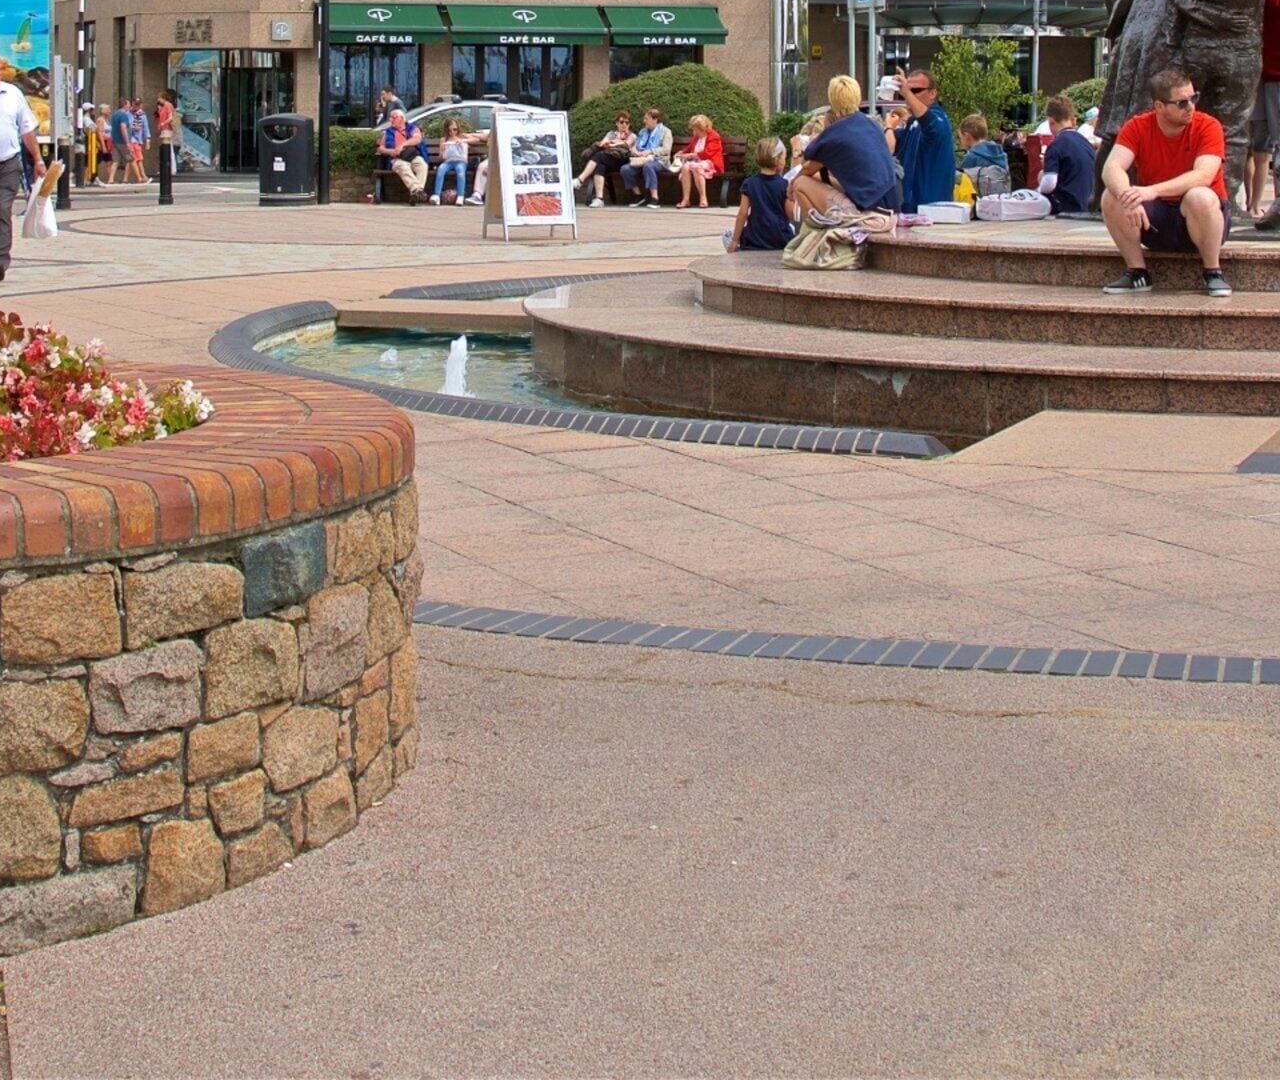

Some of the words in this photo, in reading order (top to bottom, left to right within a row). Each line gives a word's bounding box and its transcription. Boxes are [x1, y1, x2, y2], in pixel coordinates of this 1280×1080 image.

[176, 29, 212, 43] BAR
[356, 33, 385, 43] CAFÉ
[389, 35, 413, 43] BAR
[500, 34, 529, 44] CAFÉ
[532, 36, 555, 44] BAR
[643, 35, 671, 45] CAFÉ
[675, 37, 697, 45] BAR
